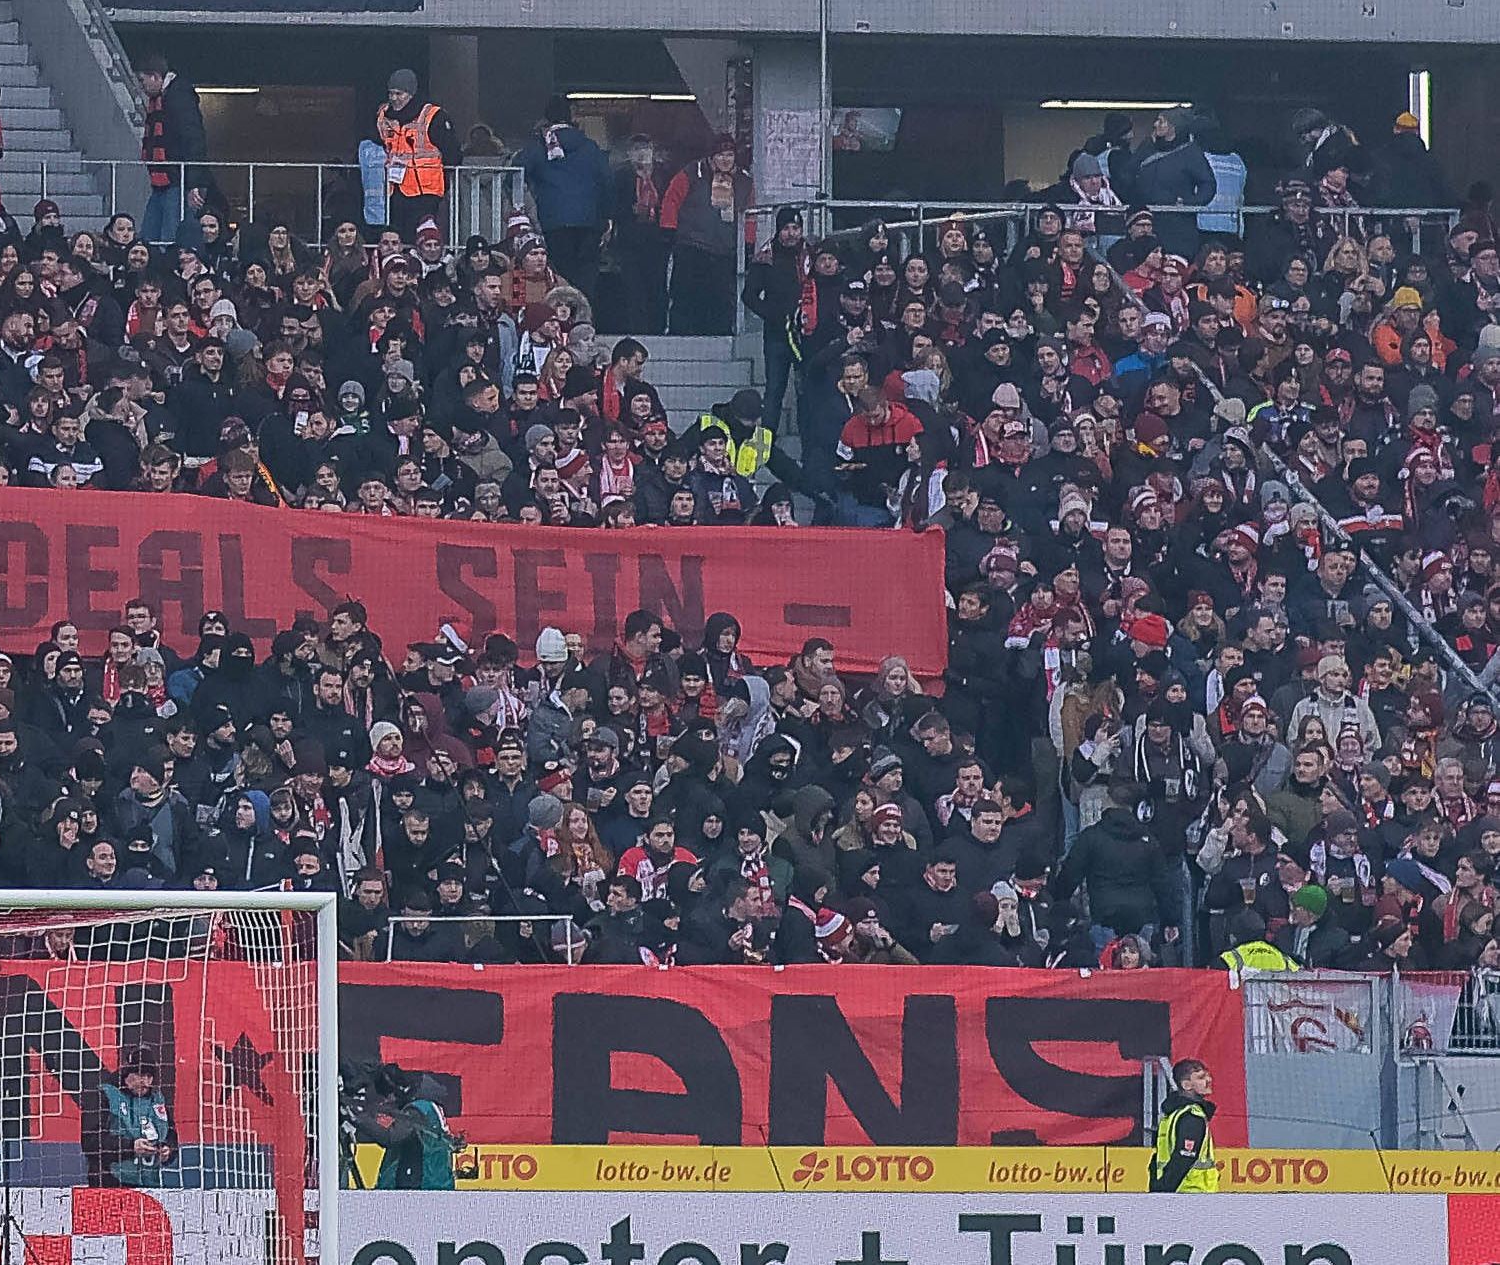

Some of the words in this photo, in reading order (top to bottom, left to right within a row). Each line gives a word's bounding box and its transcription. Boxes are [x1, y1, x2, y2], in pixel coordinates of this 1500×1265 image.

[434, 540, 706, 653] SEIN
[334, 982, 1171, 1147] FANS
[595, 1158, 732, 1183] lotto-bw.de
[836, 1154, 934, 1182] LOTTO
[988, 1161, 1126, 1184] lotto-bw.de
[1231, 1157, 1329, 1186] LOTTO
